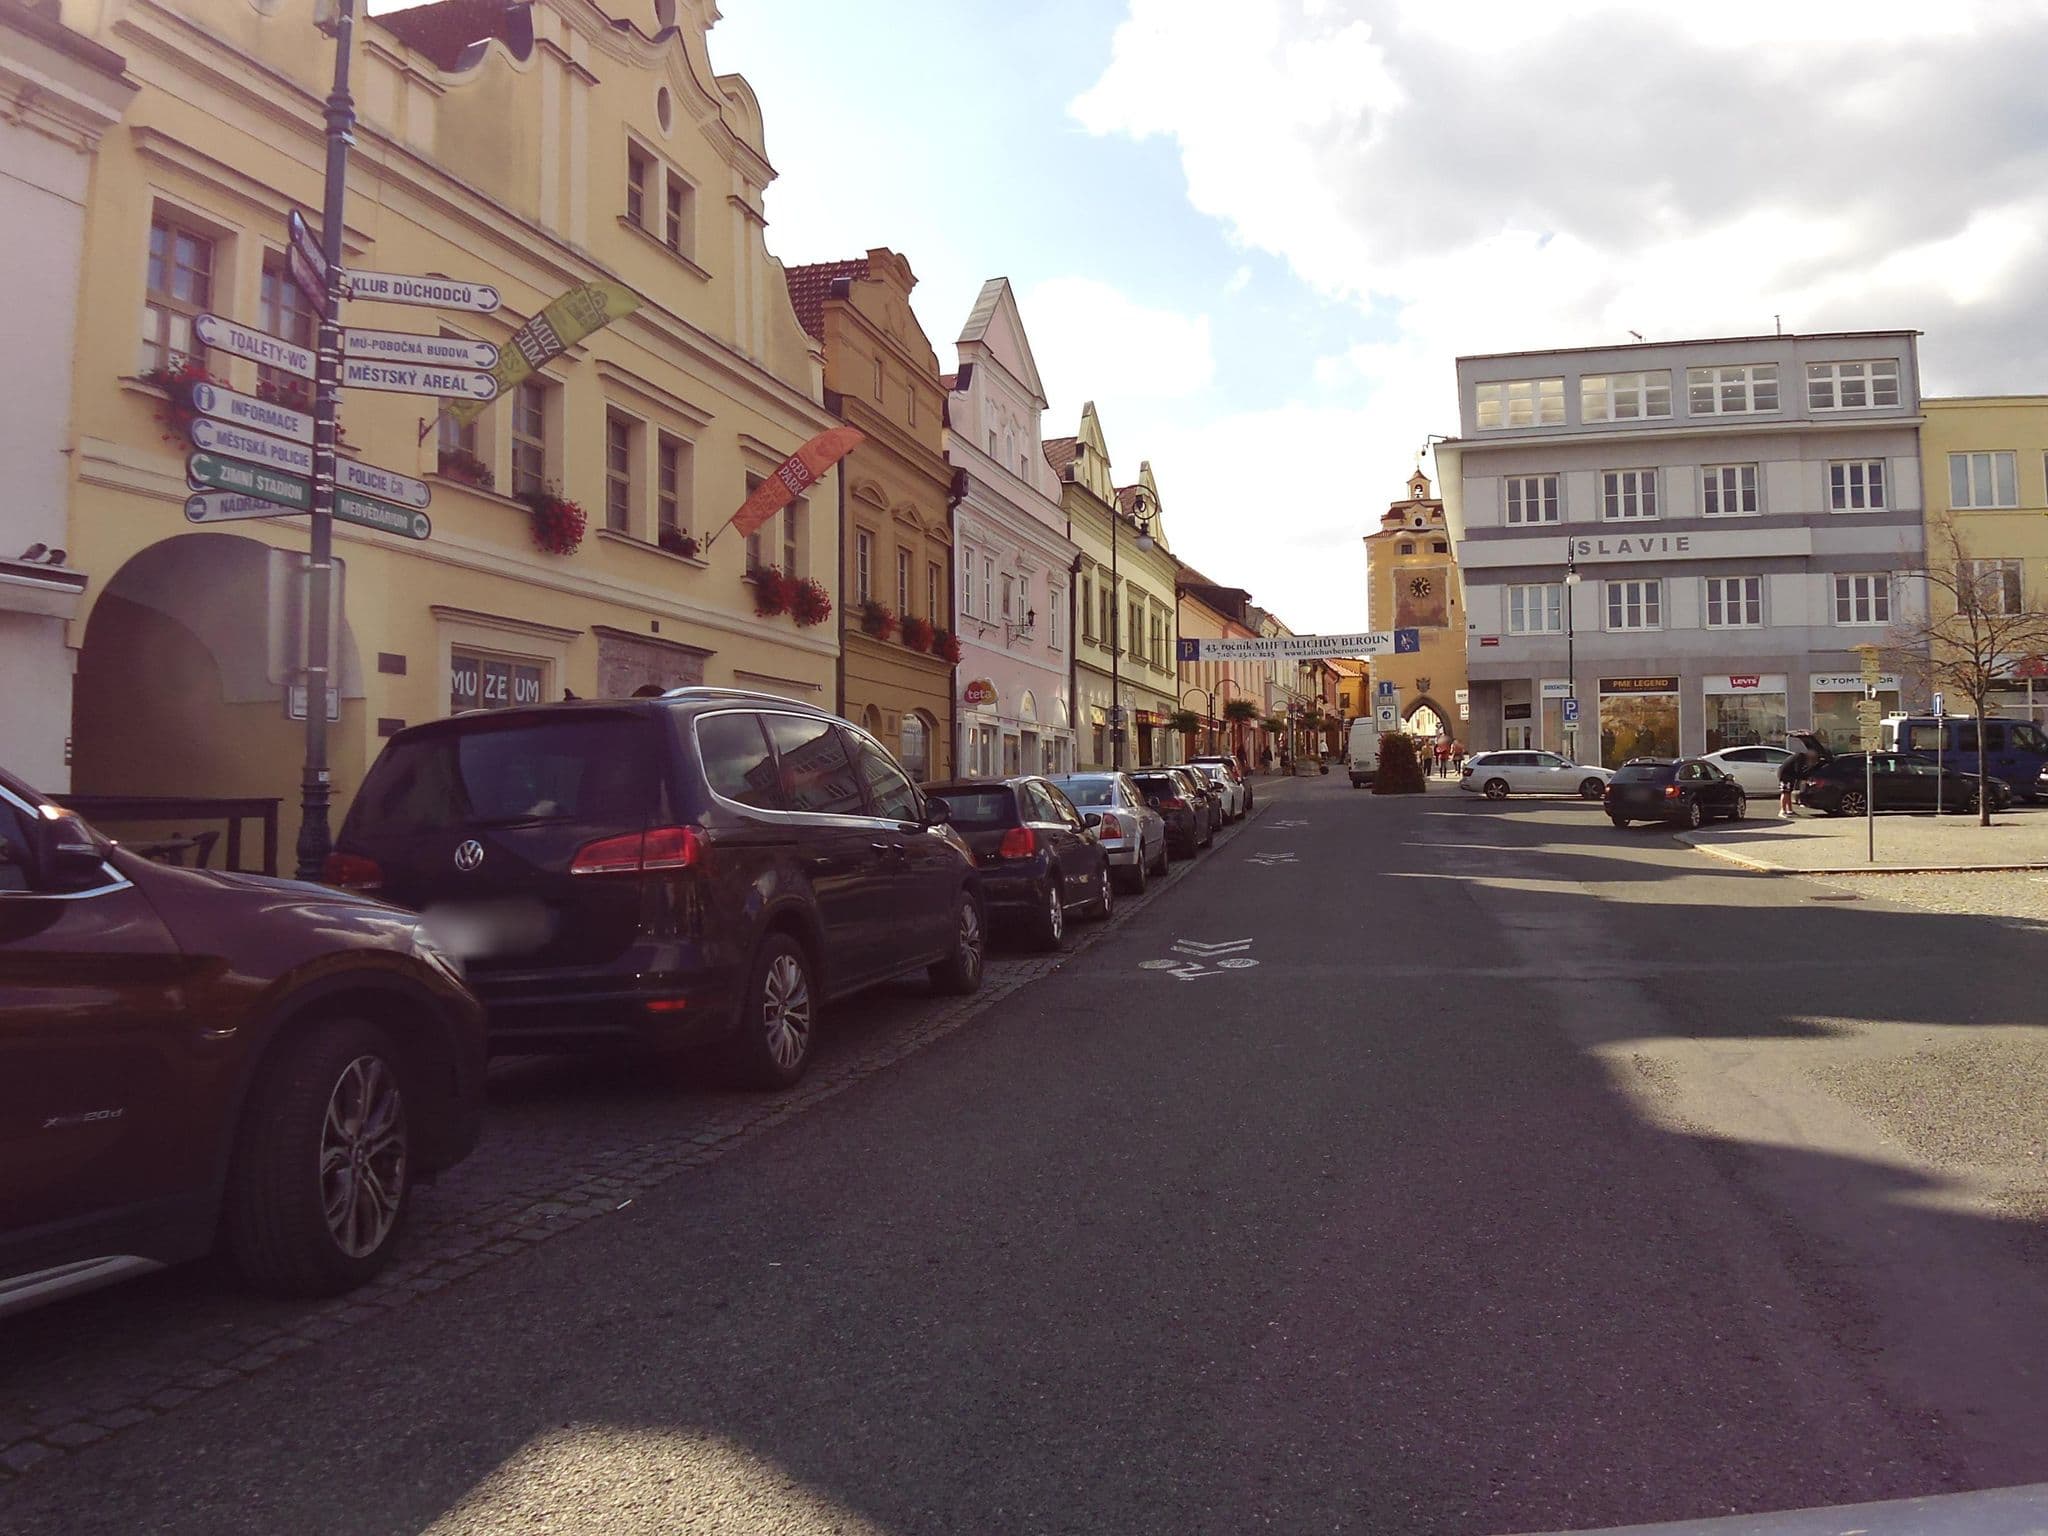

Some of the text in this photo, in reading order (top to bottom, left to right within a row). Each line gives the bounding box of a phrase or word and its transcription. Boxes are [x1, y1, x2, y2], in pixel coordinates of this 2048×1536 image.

[351, 277, 388, 294] KLUB
[229, 329, 307, 370] TOALETY-WC
[427, 345, 469, 359] BUDOVA
[348, 365, 468, 391] MĚSTSKÝ AREÁL
[231, 400, 299, 432] INFORMACE
[216, 430, 310, 468] MĚSTSKÁ POLICIE
[348, 467, 404, 496] POLICIE ČR
[778, 466, 804, 496] PARK
[789, 457, 809, 480] GEO
[220, 464, 303, 500] ZIMNÍ STADION
[341, 499, 408, 529] MEDVĚDÁRIUM
[1577, 536, 1690, 555] SLAVIE
[1221, 641, 1252, 651] ročník
[1255, 641, 1279, 650] MHF
[1341, 635, 1389, 647] BEROUN
[969, 689, 993, 700] teta
[1633, 679, 1669, 687] LEGEND
